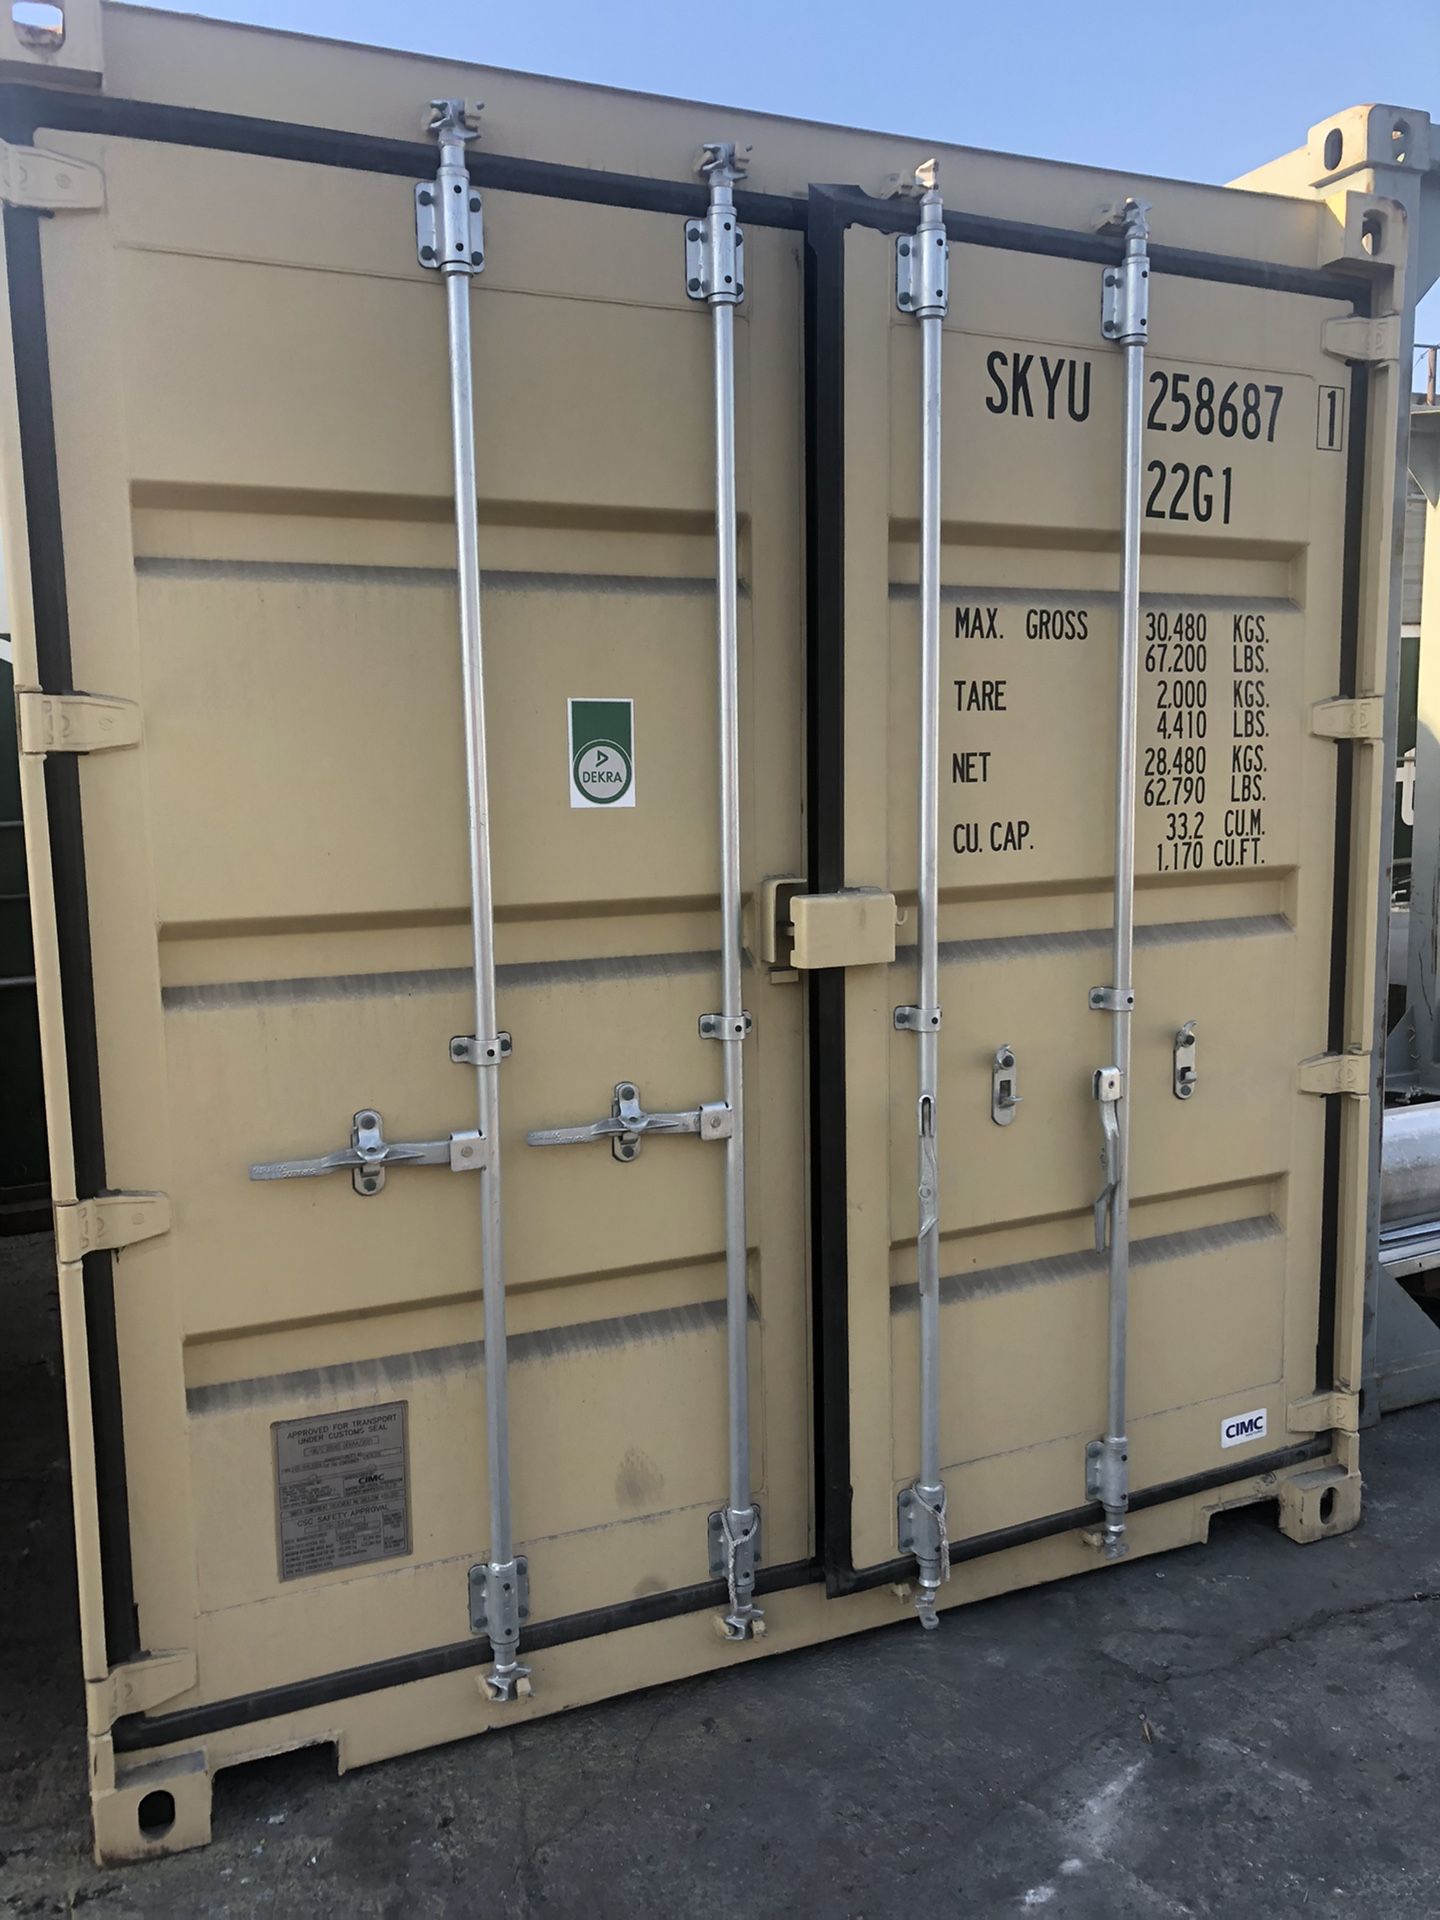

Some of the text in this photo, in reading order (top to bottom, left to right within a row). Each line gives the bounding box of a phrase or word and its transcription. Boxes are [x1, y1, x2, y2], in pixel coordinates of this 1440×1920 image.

[985, 350, 1337, 447] SKYU 258687 1
[1145, 459, 1232, 525] 22G1
[954, 606, 1269, 644] MAX. GROSS 30,480 KGS.
[1145, 643, 1269, 673] 67,200 LBS.
[953, 679, 1270, 712] TARE 2,000 KGS.
[1156, 709, 1269, 740] 4,410 LBS.
[582, 771, 623, 783] DEKRA
[952, 744, 1267, 784] NET 28,480 KGS.
[1143, 773, 1266, 807] 62,790 LBS.
[953, 822, 983, 854] CU.
[990, 820, 1034, 852] CAP.
[1165, 811, 1205, 841] 33.2
[1157, 840, 1203, 872] 1,170
[287, 1413, 397, 1439] APPROVED FOR TRANSPORT
[298, 1423, 387, 1445] UNDER CUSTOMS SEAL
[1225, 1416, 1264, 1438] CIMC
[358, 1473, 384, 1485] CIMC
[297, 1517, 313, 1527] CSC
[317, 1511, 347, 1523] SAFETY
[350, 1504, 390, 1518] APPROVAL
